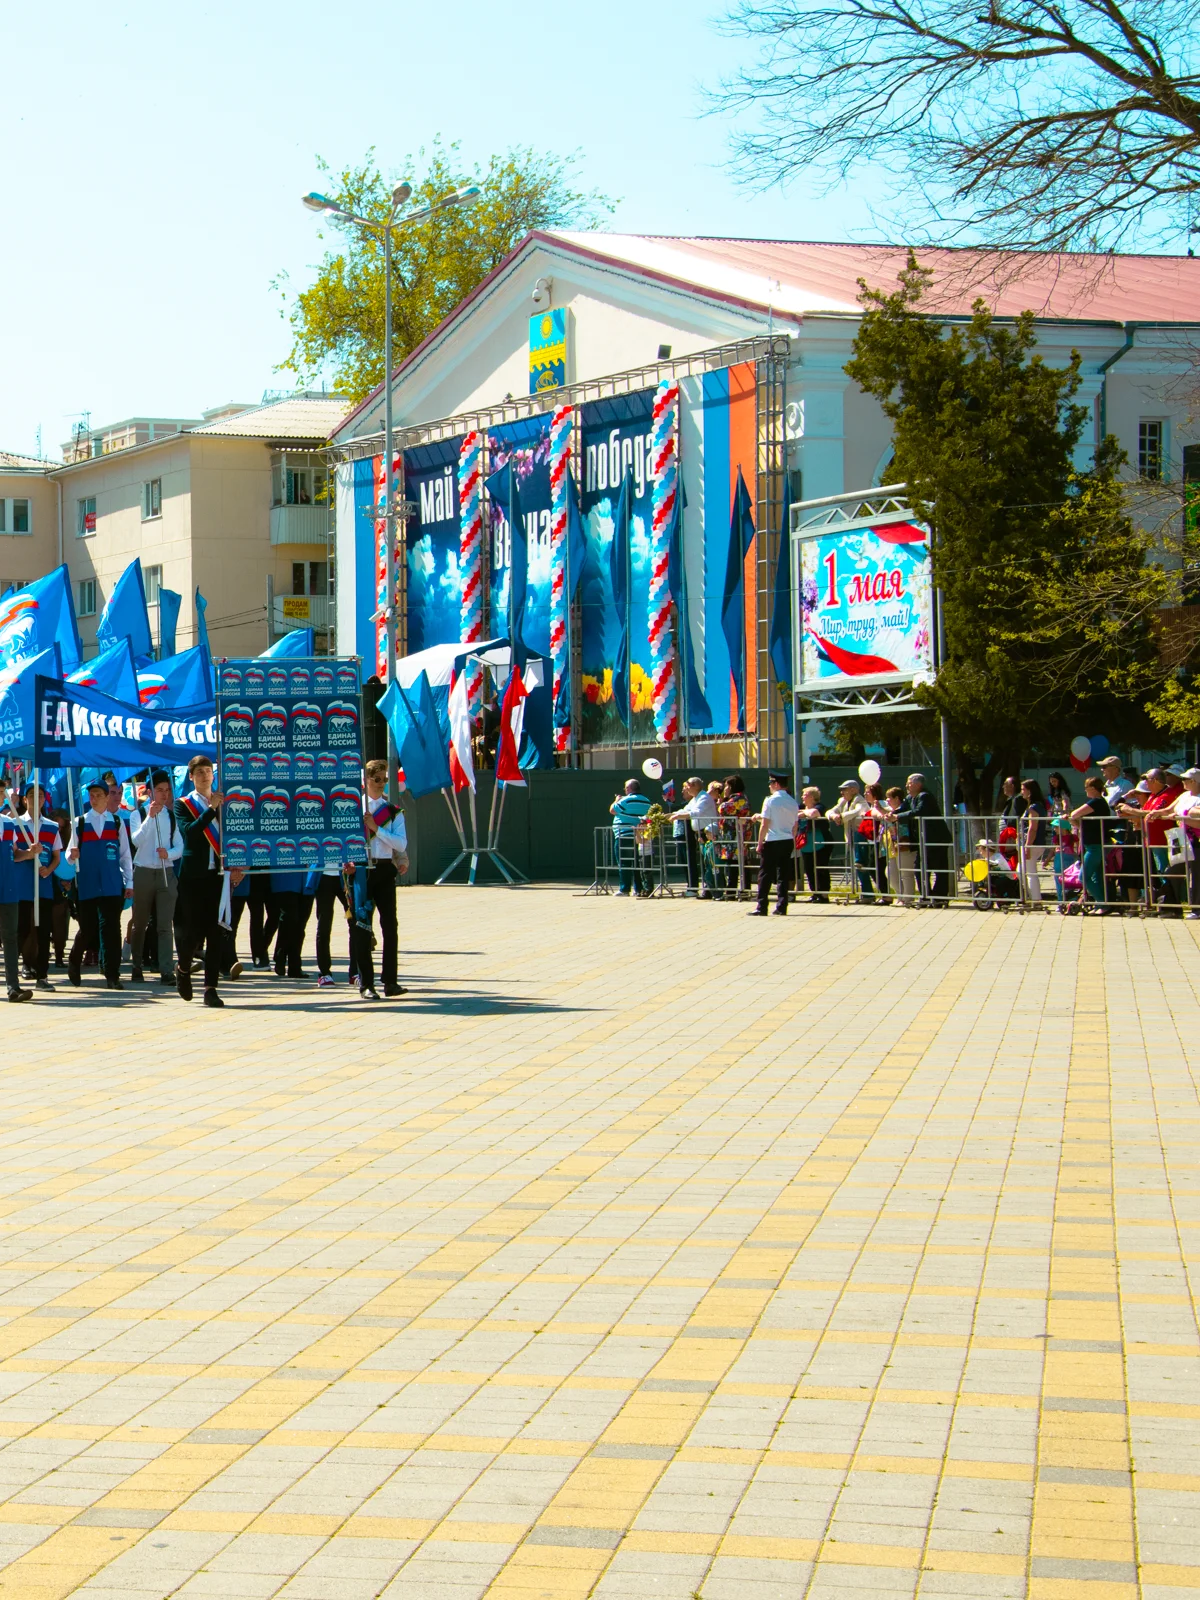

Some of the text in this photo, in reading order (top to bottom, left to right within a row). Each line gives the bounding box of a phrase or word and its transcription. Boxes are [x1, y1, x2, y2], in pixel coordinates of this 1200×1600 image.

[420, 465, 454, 525] май
[824, 551, 905, 606] 1 мая
[819, 608, 910, 642] Мир, труд, май!
[41, 700, 221, 745] ЕДИНАЯ РОСС
